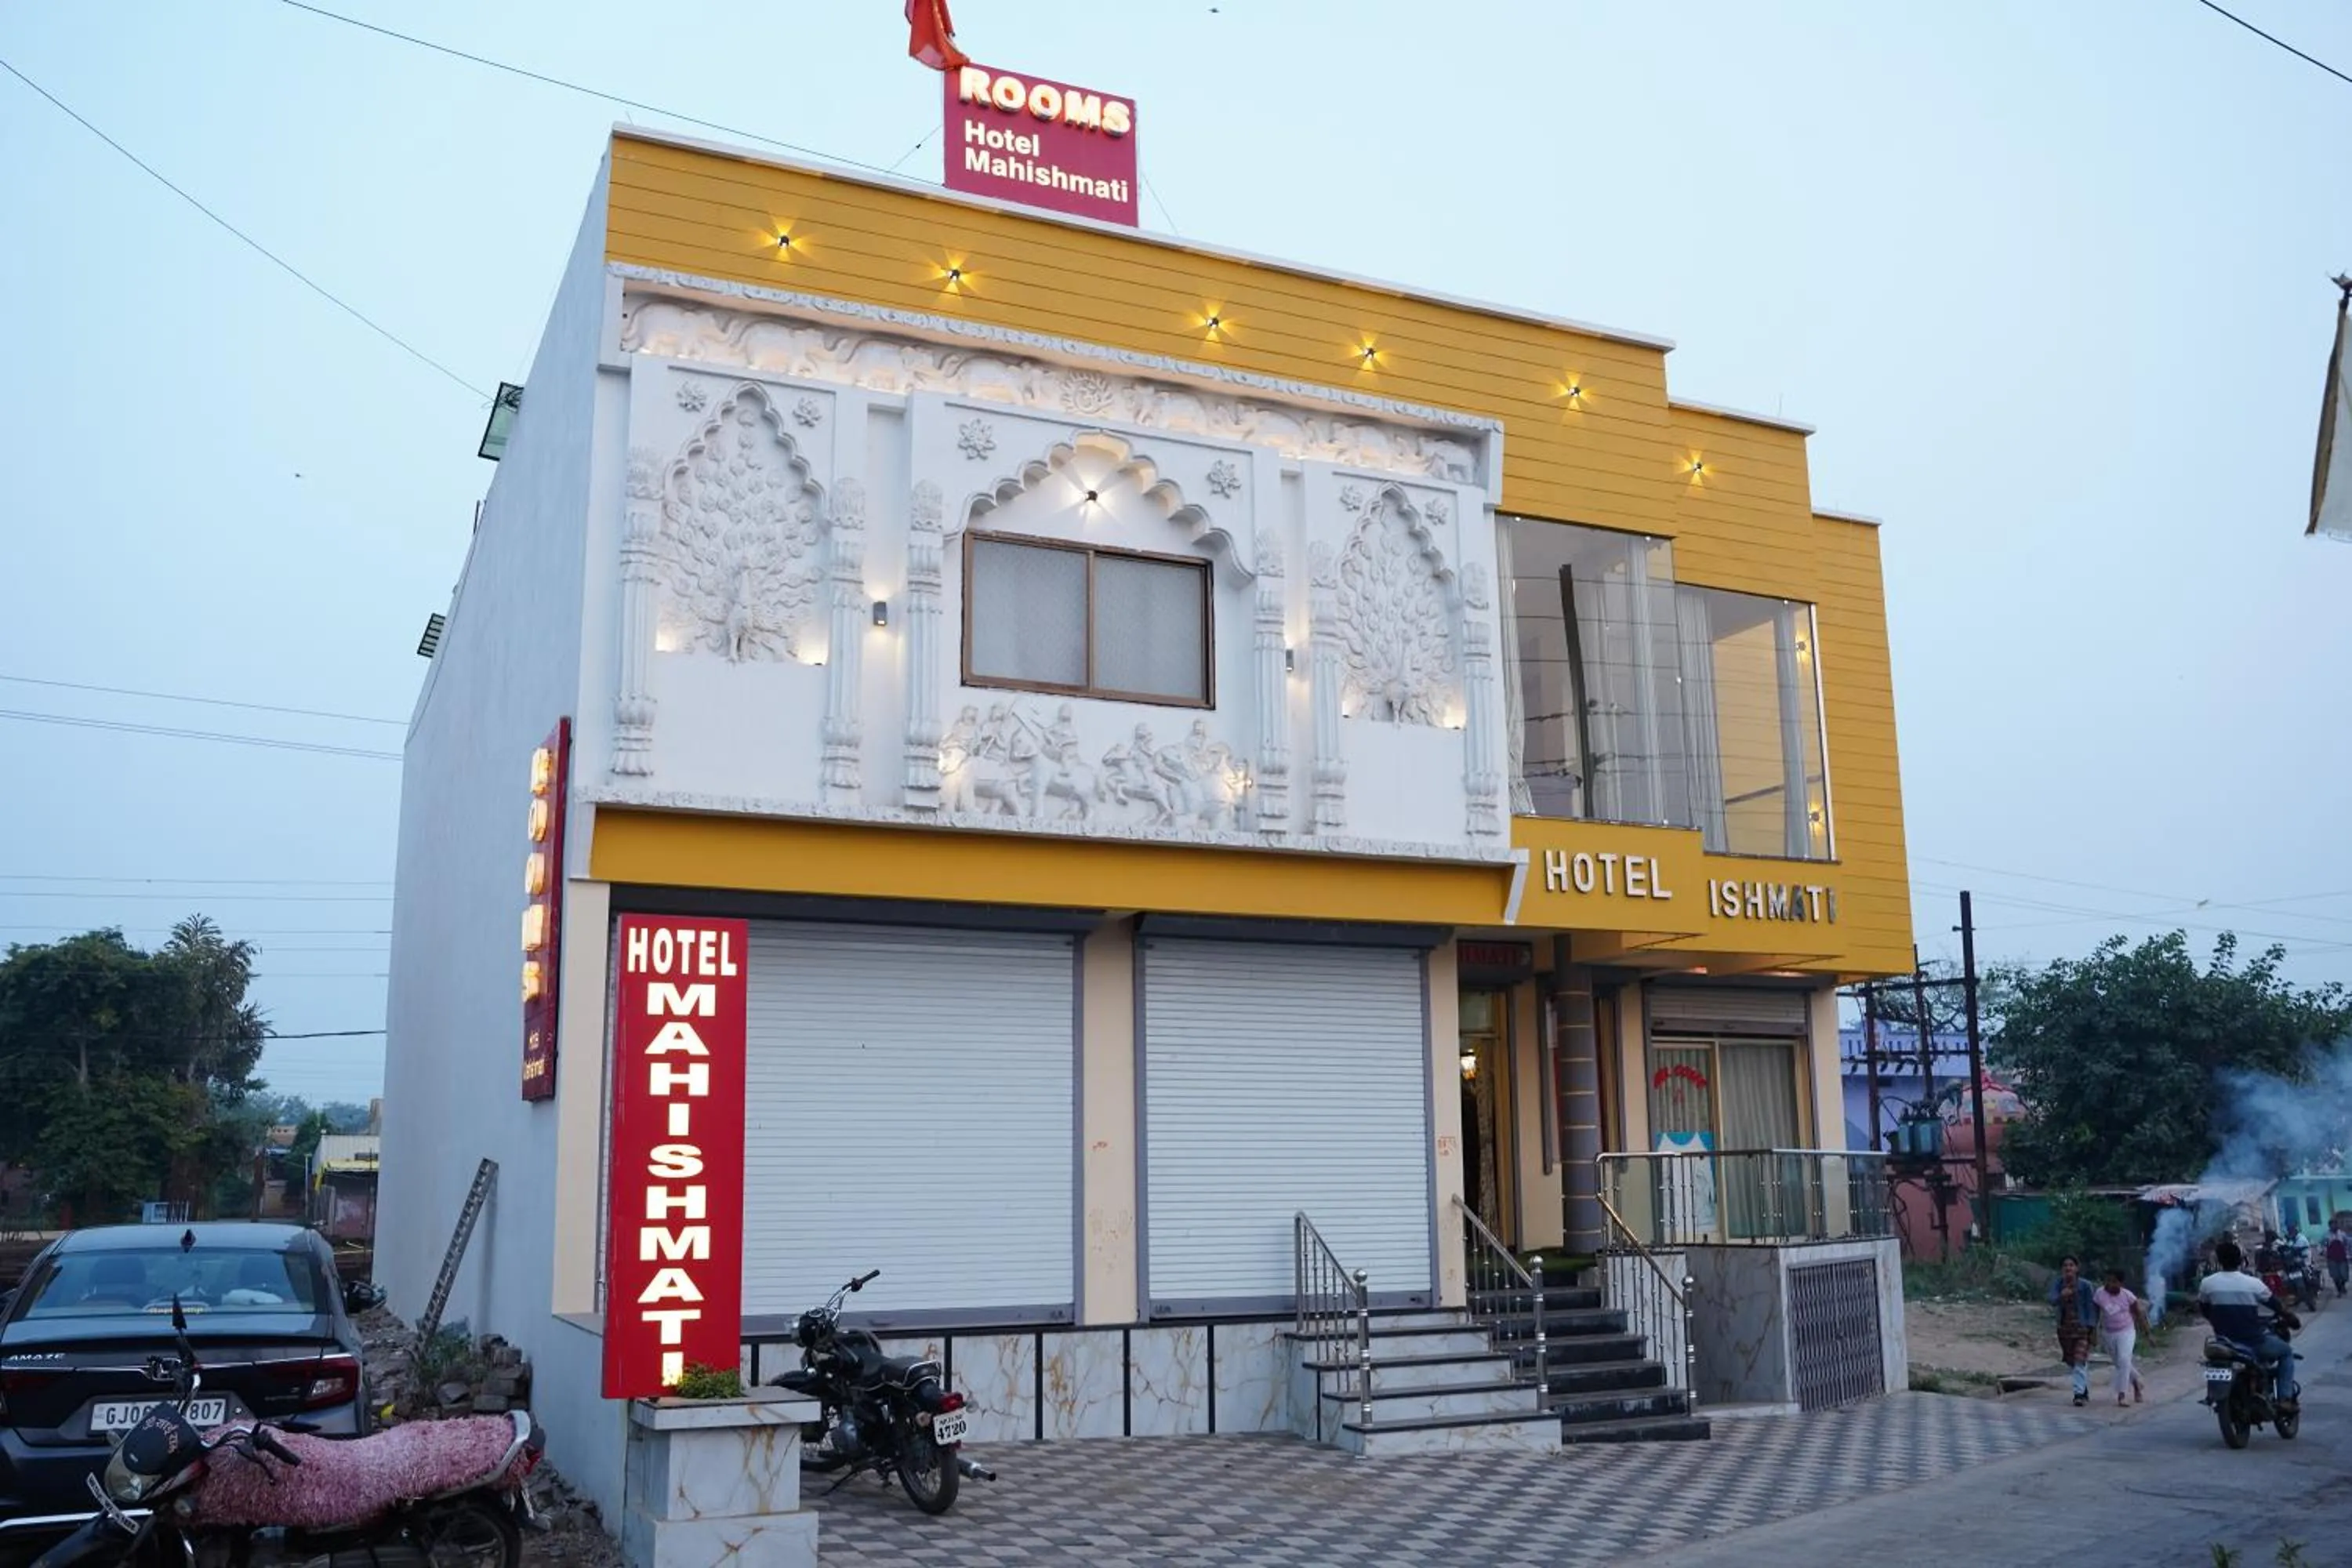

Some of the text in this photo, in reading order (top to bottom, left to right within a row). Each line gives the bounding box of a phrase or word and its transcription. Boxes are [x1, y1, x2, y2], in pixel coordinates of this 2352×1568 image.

[959, 66, 1131, 136] ROOMS
[965, 119, 1040, 157] Hotel
[965, 147, 1128, 203] Mahishmati
[1544, 849, 1836, 924] HOTEL ISHMATI
[627, 927, 737, 976] HOTEL
[637, 982, 716, 1387] MAHISHMATI
[937, 1420, 967, 1439] 4720
